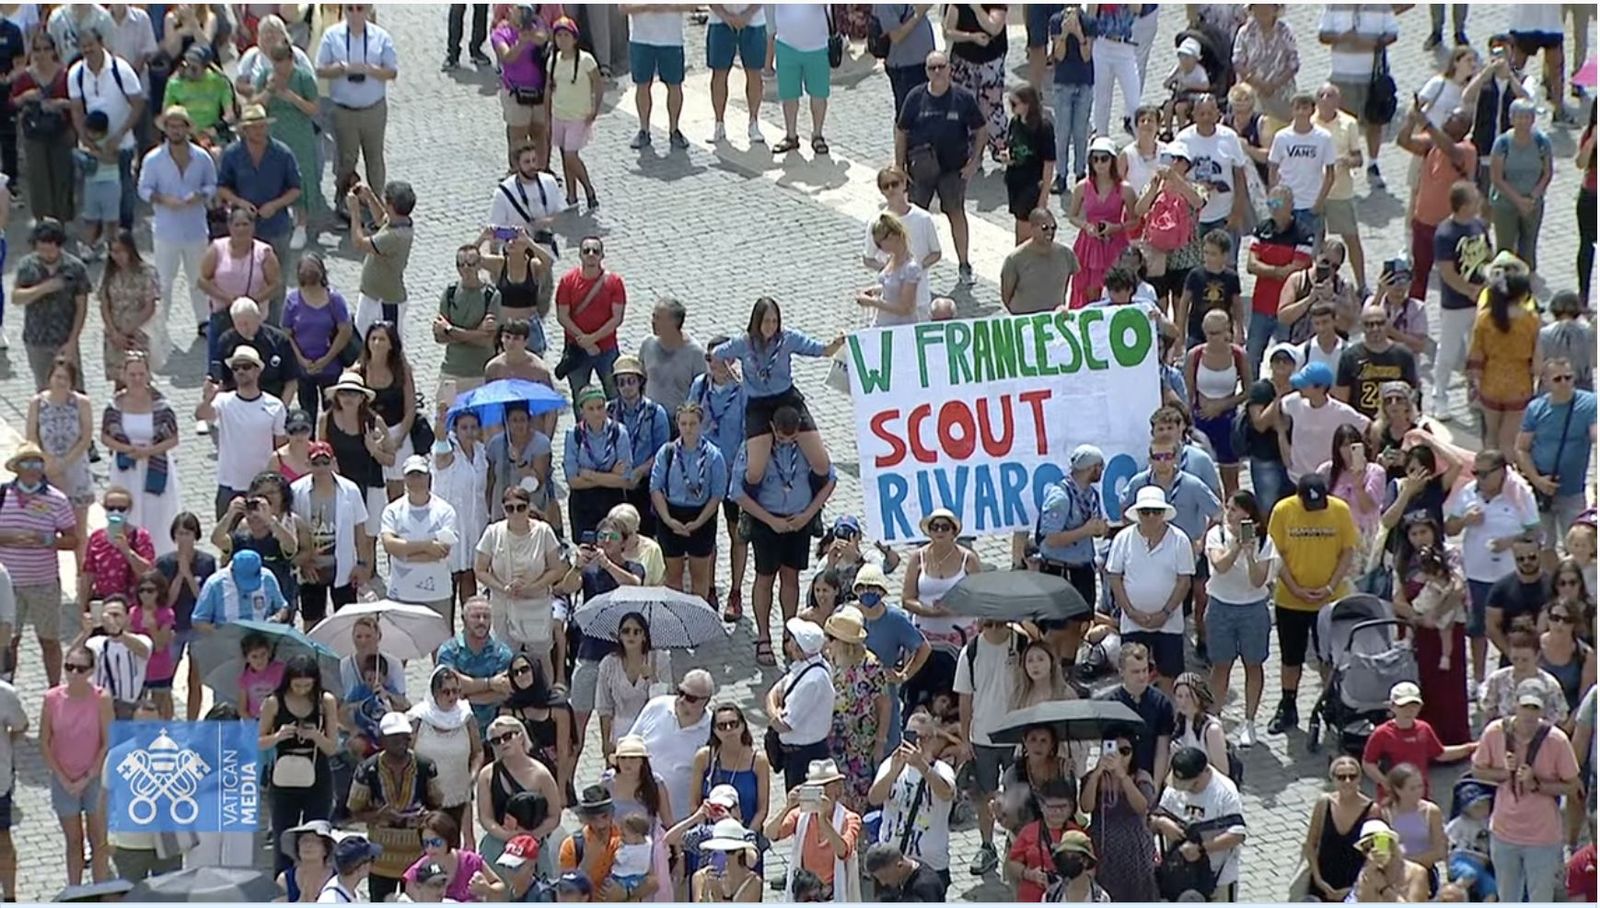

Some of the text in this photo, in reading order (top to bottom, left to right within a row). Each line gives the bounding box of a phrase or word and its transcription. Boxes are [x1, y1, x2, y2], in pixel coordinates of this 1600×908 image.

[1286, 144, 1317, 159] VANS
[848, 306, 1152, 394] W FRANCESCO
[870, 389, 1052, 467] SCOUT
[877, 453, 1139, 541] RIVAROO
